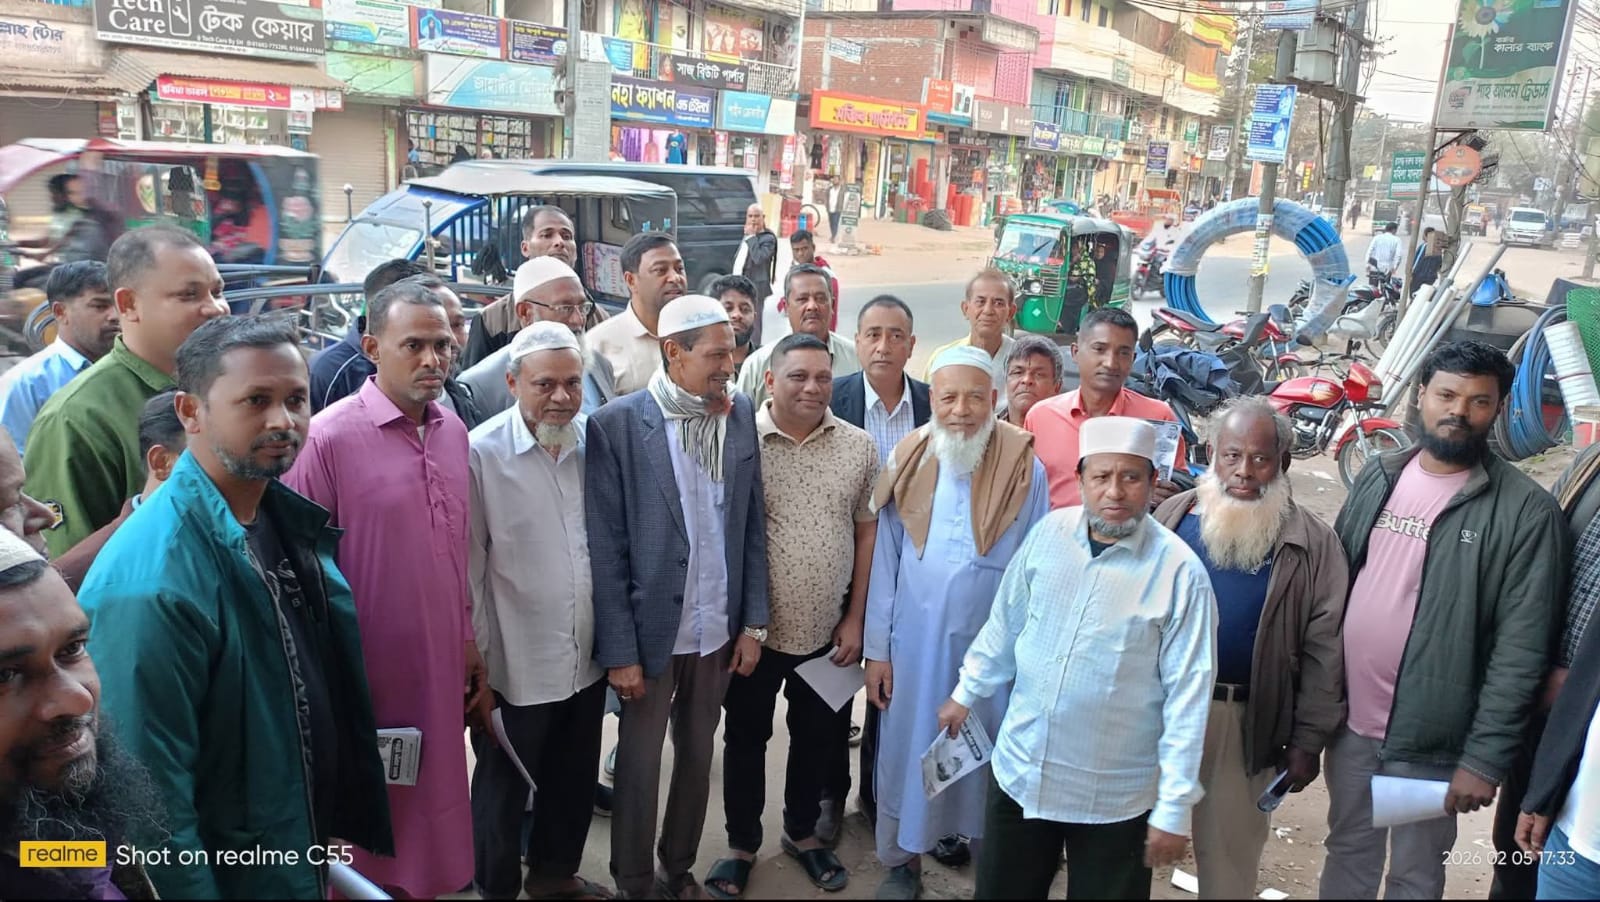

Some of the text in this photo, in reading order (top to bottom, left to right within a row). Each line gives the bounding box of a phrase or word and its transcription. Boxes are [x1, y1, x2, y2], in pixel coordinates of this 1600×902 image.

[109, 9, 166, 33] Care
[199, 5, 244, 33] টেক
[252, 16, 314, 42] কেয়ার
[696, 62, 720, 81] বিউটি
[610, 82, 634, 109] নহা
[636, 84, 676, 112] ফ্যাশন
